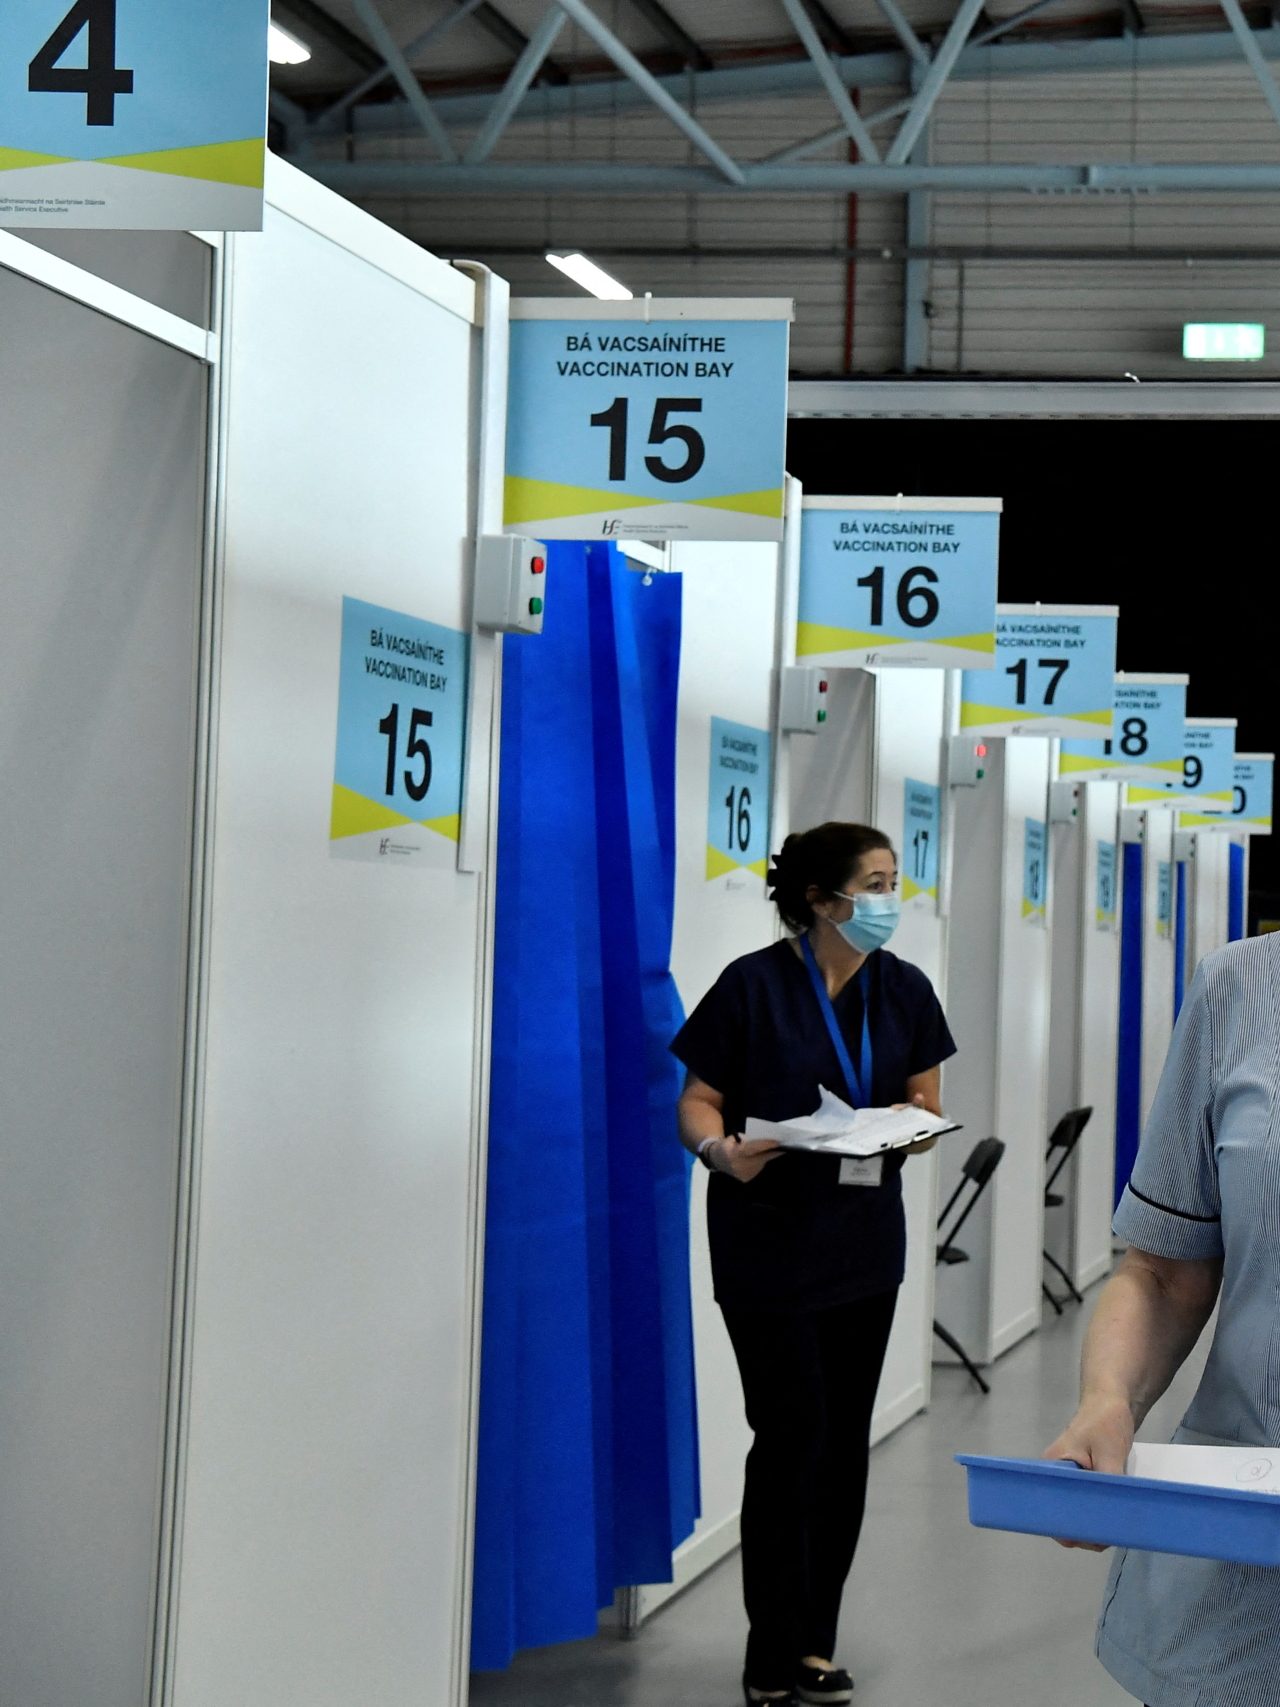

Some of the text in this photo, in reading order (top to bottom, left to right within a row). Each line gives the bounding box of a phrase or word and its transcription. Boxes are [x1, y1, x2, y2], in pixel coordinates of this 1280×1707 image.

[28, 0, 134, 127] 4
[566, 331, 726, 353] BÁ VACSAÍNÍTHE
[557, 361, 734, 378] VACCINATION BAY
[590, 397, 706, 483] 15
[833, 540, 961, 554] VACCINATION BAY
[840, 519, 955, 536] BÁ VACSAÍNÍTHE
[857, 566, 939, 628] 16
[370, 628, 384, 649] BÁ
[996, 638, 1086, 648] ACCINATION BAY
[365, 656, 447, 692] VACCINATION BAY
[1006, 658, 1070, 705] 17
[379, 702, 433, 801] 15
[725, 785, 751, 852] 16
[913, 829, 929, 879] 17
